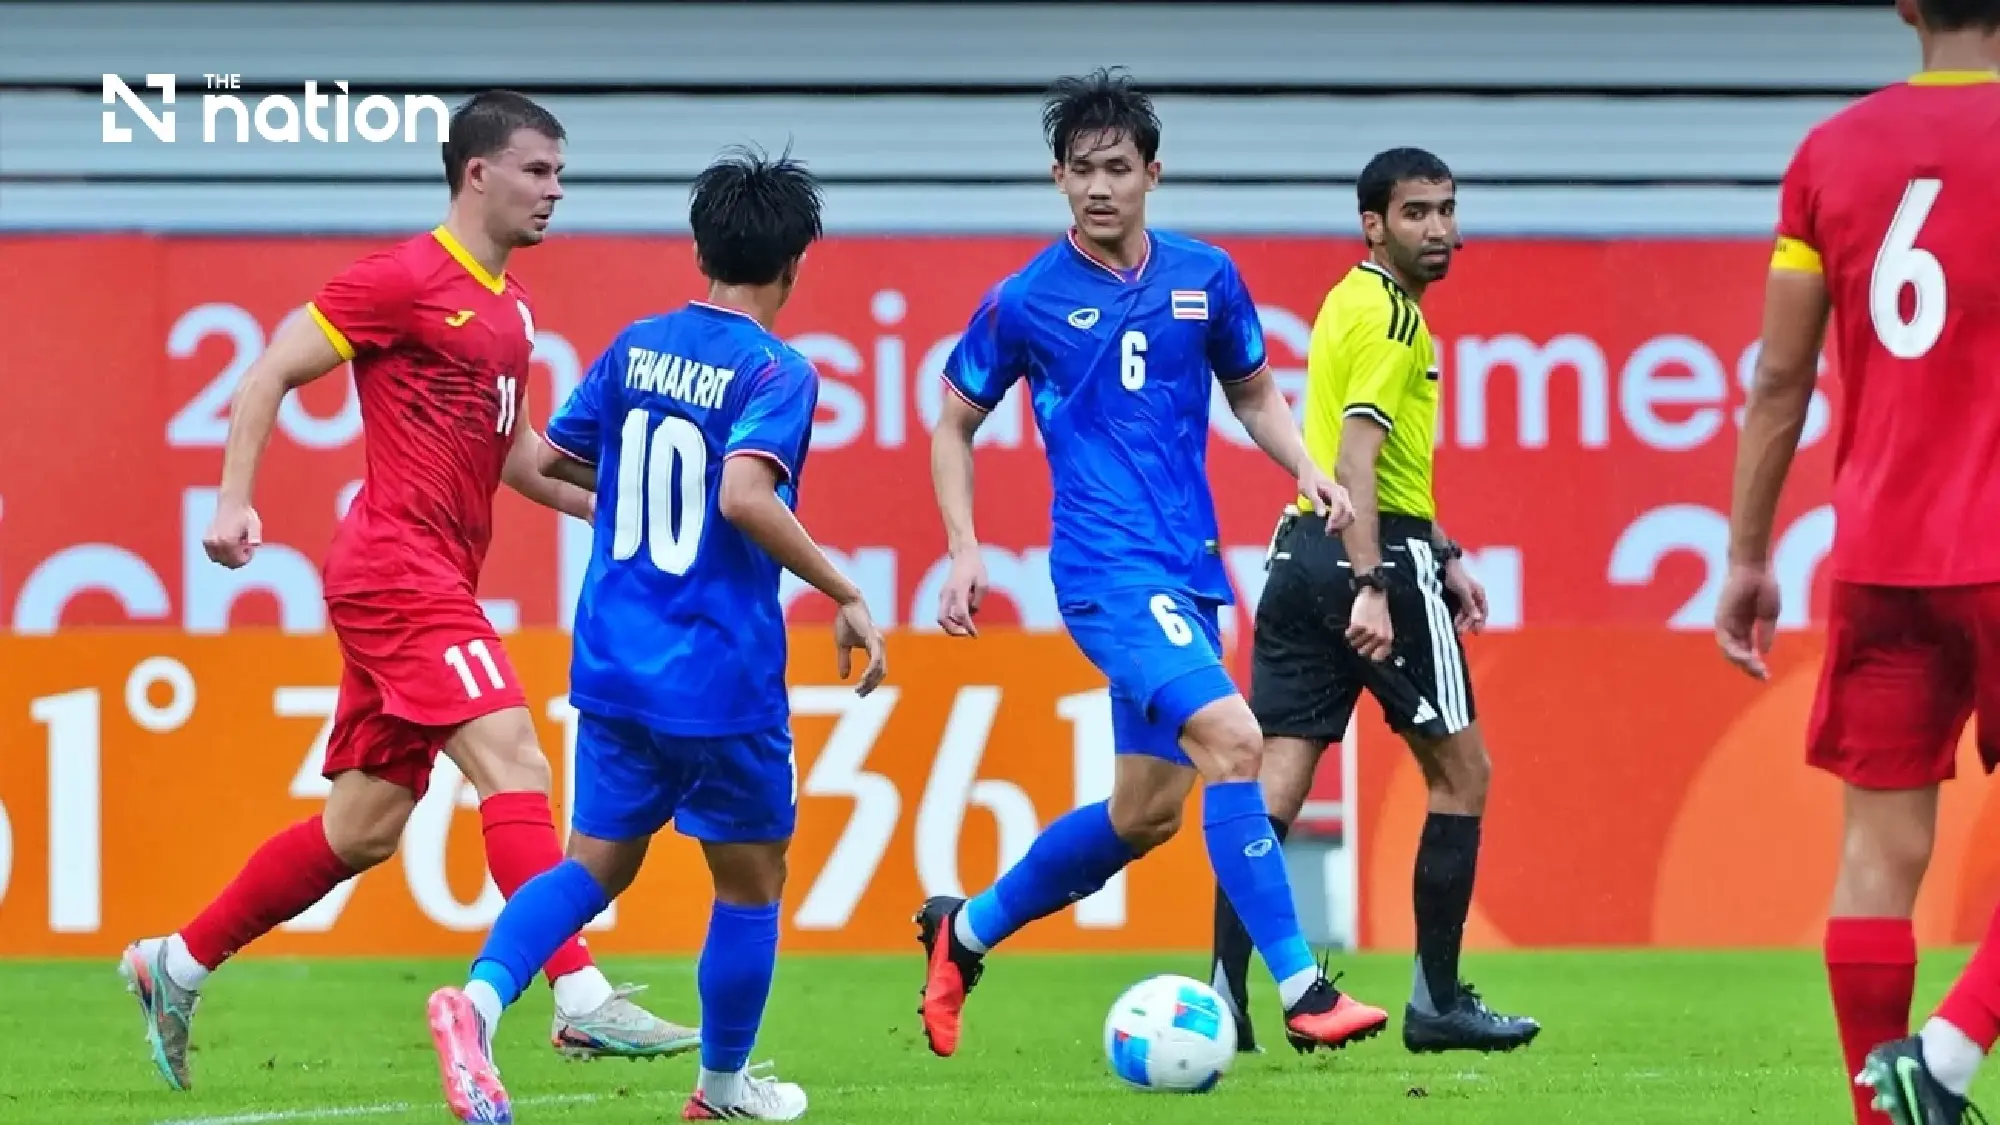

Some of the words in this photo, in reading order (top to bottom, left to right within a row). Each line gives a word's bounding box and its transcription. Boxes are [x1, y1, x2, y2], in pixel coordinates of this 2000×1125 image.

[1869, 178, 1947, 359] 6
[496, 375, 516, 437] 11
[784, 288, 1047, 450] sia
[1204, 303, 1832, 452] Gme
[1121, 330, 1148, 391] 6
[612, 408, 707, 576] 10
[443, 639, 506, 700] 11
[1149, 593, 1193, 647] 6
[0, 655, 198, 933] 1°
